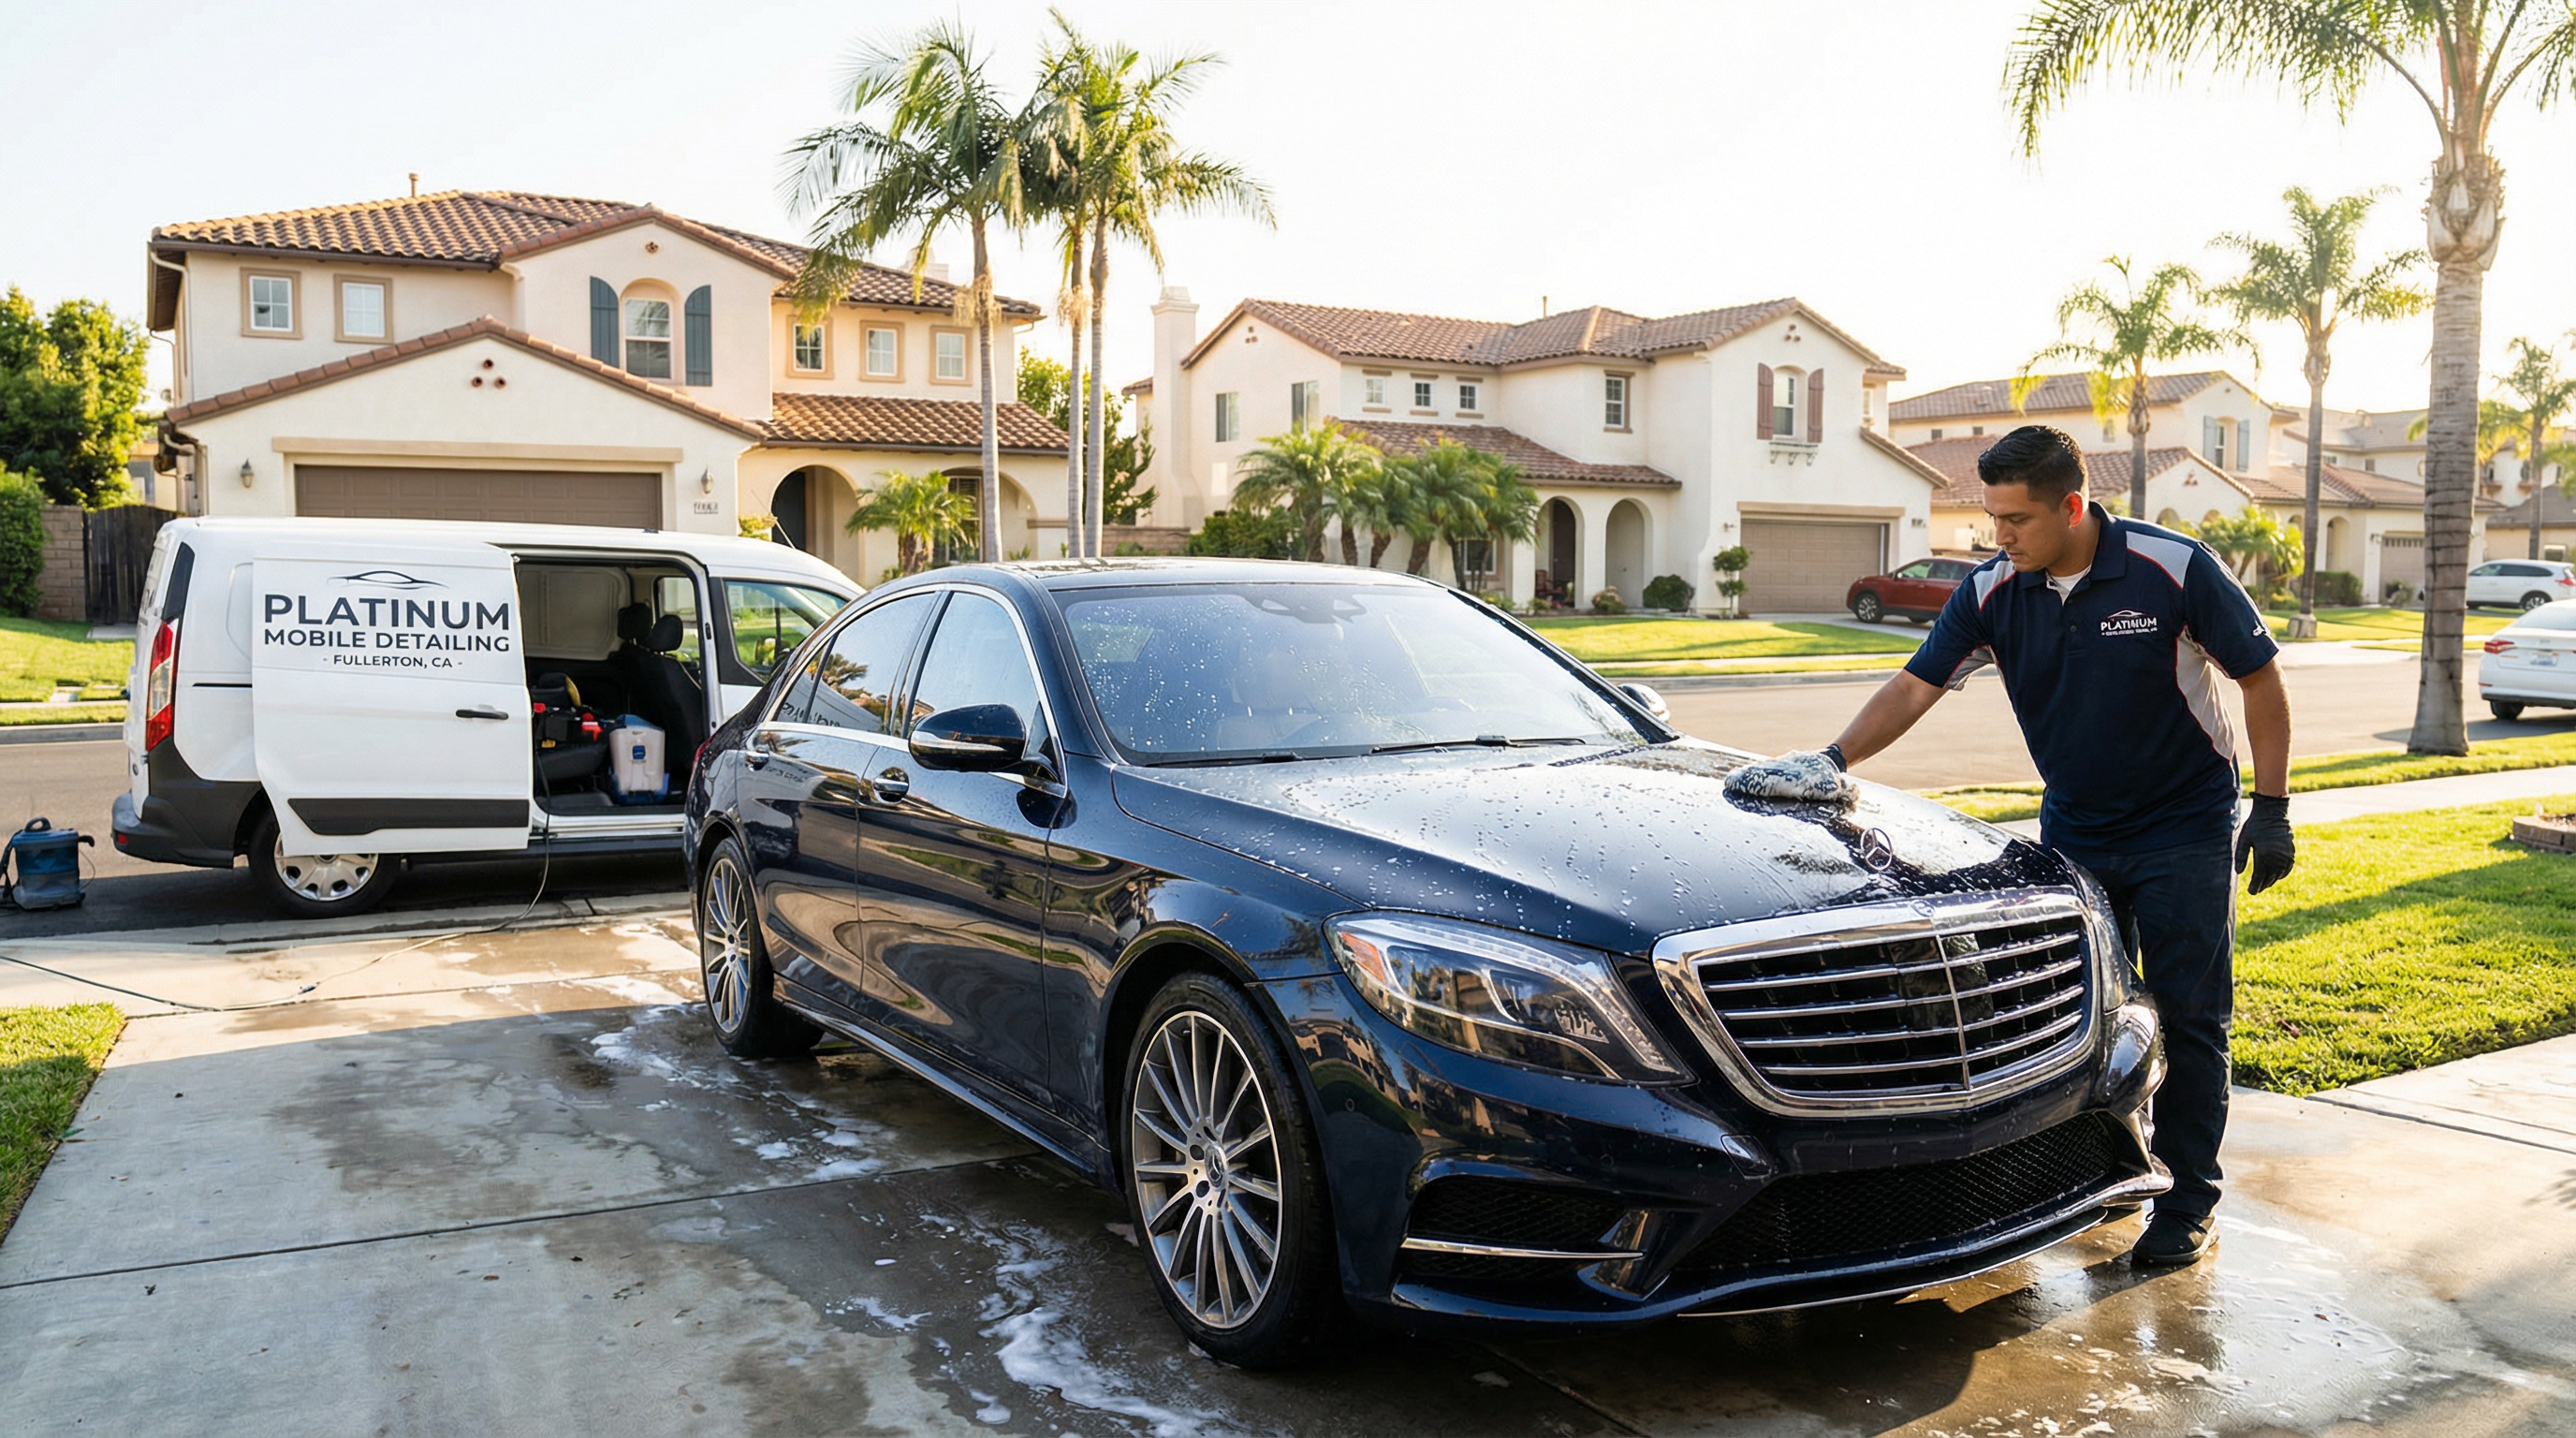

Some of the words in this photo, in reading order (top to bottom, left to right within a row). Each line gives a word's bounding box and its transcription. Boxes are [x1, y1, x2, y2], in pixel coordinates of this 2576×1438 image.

[264, 594, 509, 631] PLATINUM
[264, 628, 367, 648] MOBILE
[375, 632, 510, 653] DETAILING
[333, 654, 428, 669] FULLERTON,
[432, 656, 453, 668] CA
